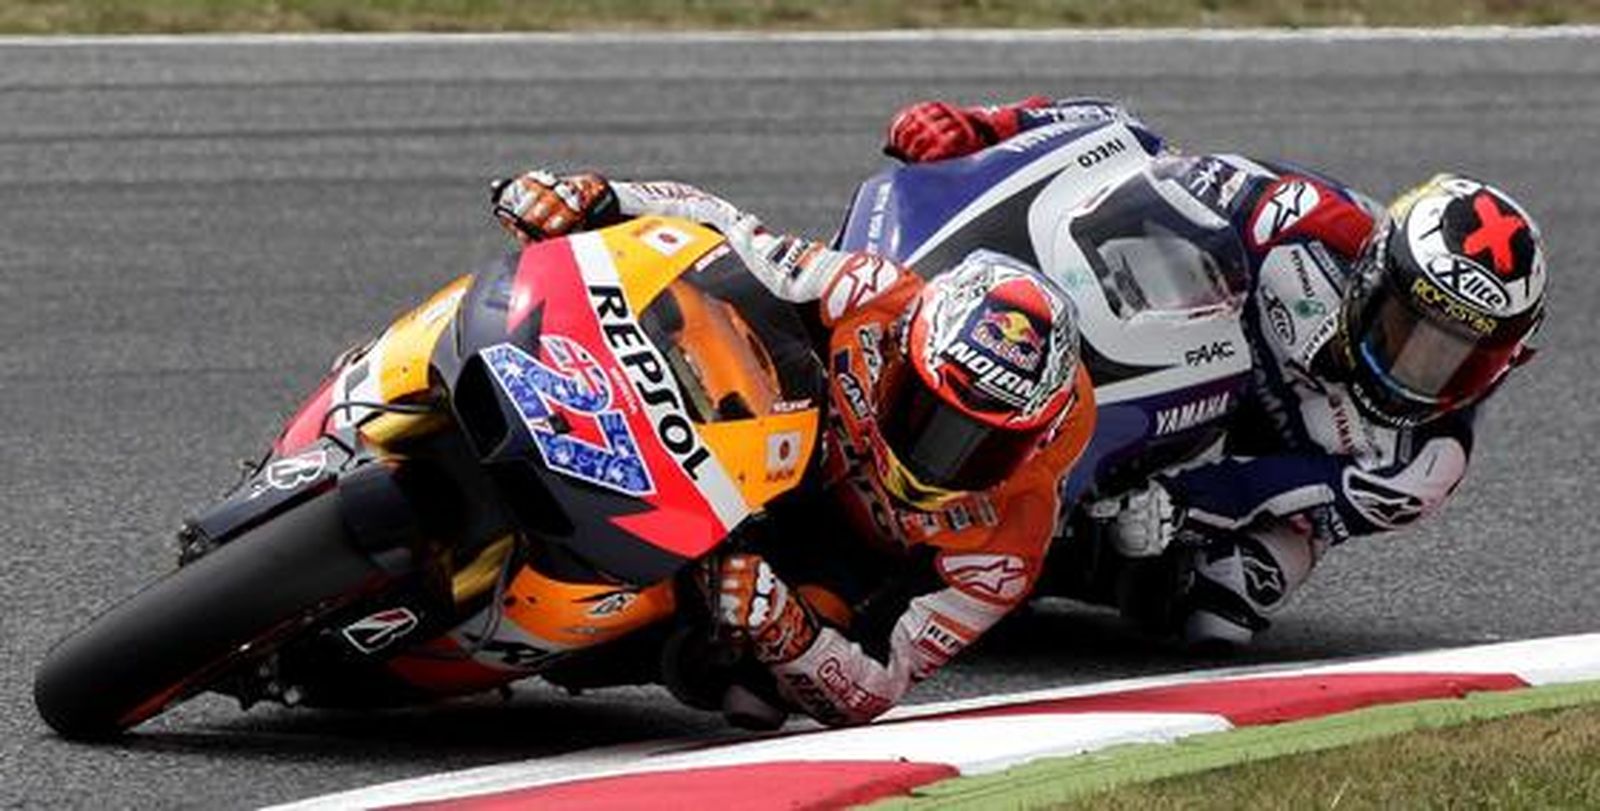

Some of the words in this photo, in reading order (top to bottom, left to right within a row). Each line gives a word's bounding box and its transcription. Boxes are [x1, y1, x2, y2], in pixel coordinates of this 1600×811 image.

[1077, 138, 1126, 168] IVECO
[588, 285, 711, 481] REPSOL
[947, 340, 1034, 398] NOLAN
[479, 334, 657, 497] 27
[1156, 391, 1230, 436] YAMAHA
